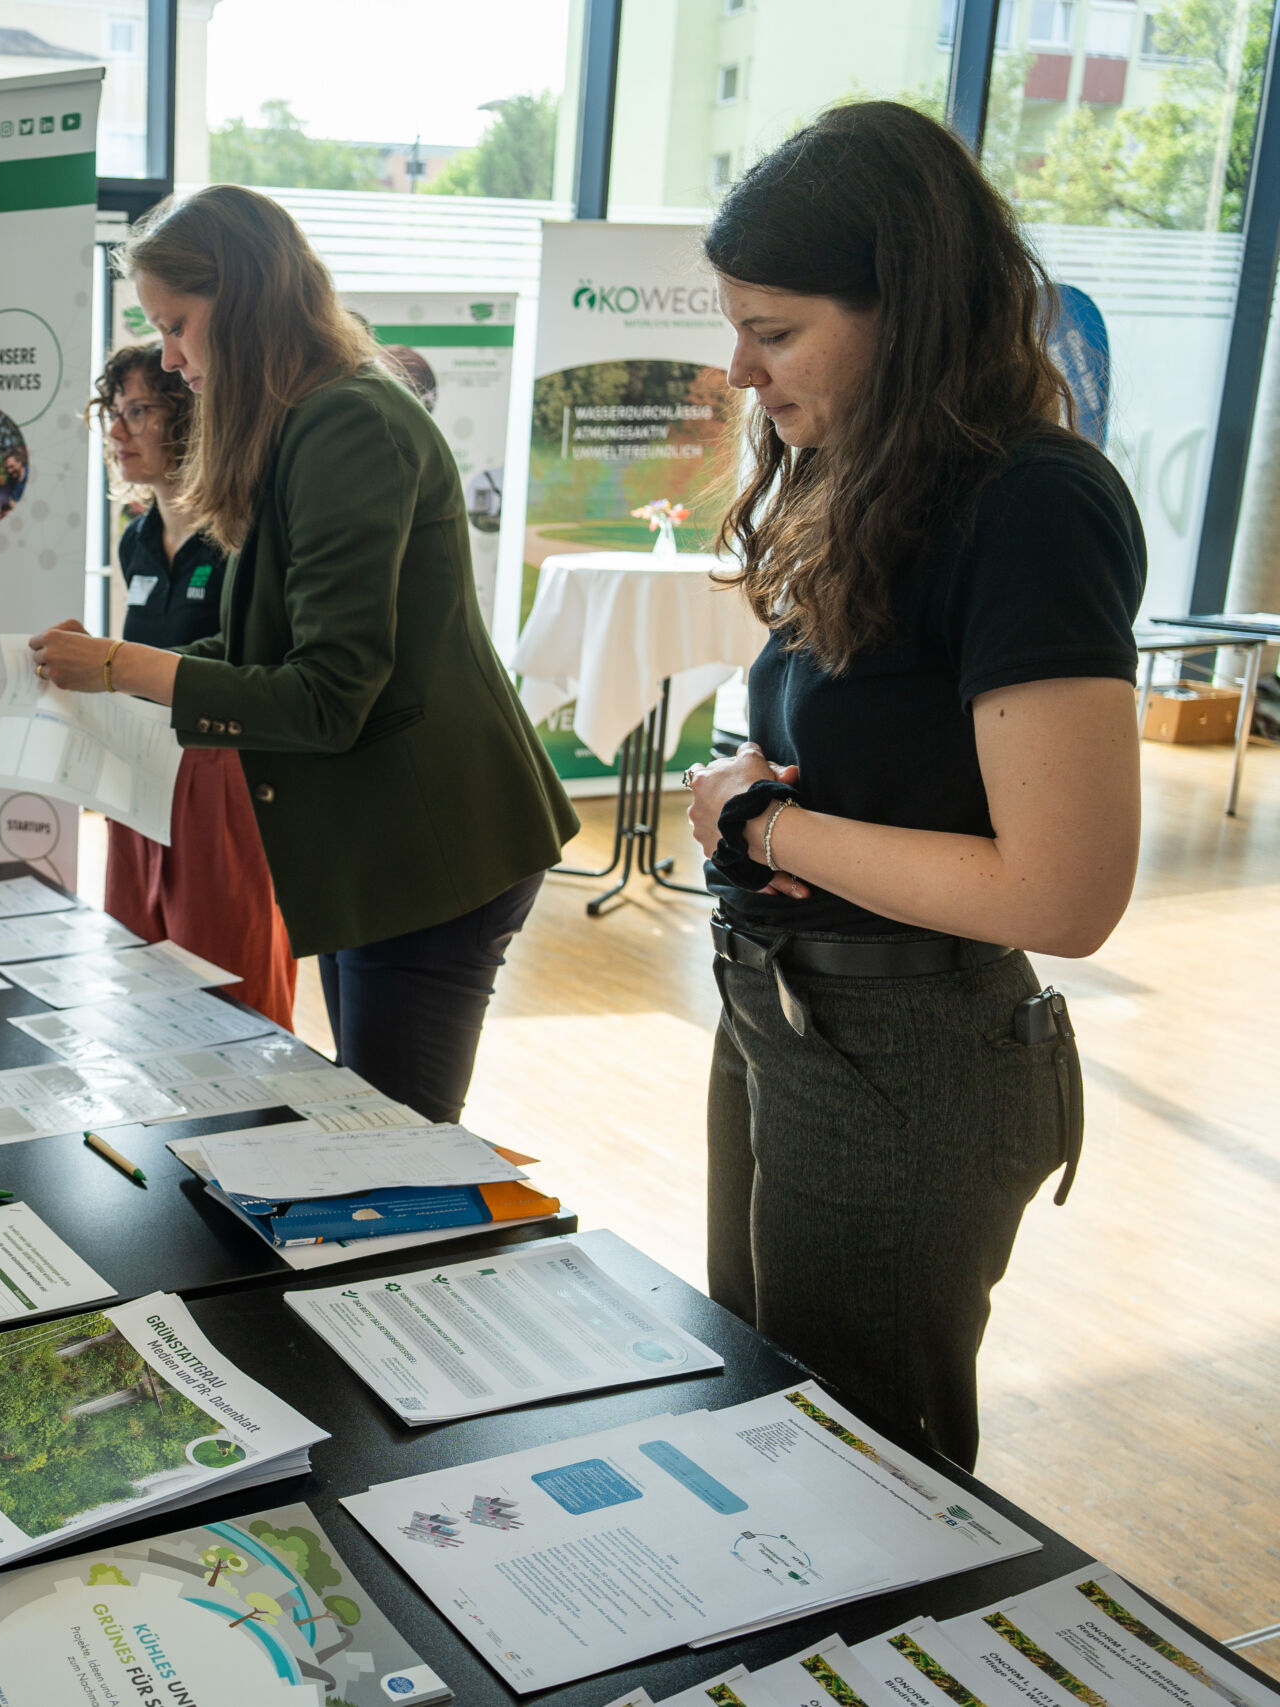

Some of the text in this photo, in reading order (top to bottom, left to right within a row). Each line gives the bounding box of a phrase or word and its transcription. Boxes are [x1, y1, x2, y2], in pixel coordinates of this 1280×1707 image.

[7, 819, 51, 835] STARTUPS
[560, 1258, 578, 1271] DAS
[146, 1315, 227, 1389] GRÜNSTATTGRAU
[147, 1340, 261, 1433] Medien und PR- Datenblatt
[67, 1655, 81, 1673] zum
[70, 1626, 91, 1659] Projekte,
[88, 1659, 105, 1682] Ideen
[100, 1683, 118, 1700] und
[93, 1603, 137, 1665] GRÜNES
[126, 1666, 154, 1697] FÜR
[133, 1623, 177, 1679] KÜHLES
[980, 1655, 1007, 1678] Pflege
[1007, 1678, 1027, 1691] und
[1084, 1619, 1122, 1650] ÖNORM
[1120, 1646, 1128, 1654] L
[1130, 1654, 1153, 1669] 1131
[1152, 1668, 1190, 1698] Beiblatt
[893, 1676, 930, 1706] ÖNORM
[989, 1652, 1024, 1681] ÖNORM
[1032, 1687, 1054, 1704] 1131
